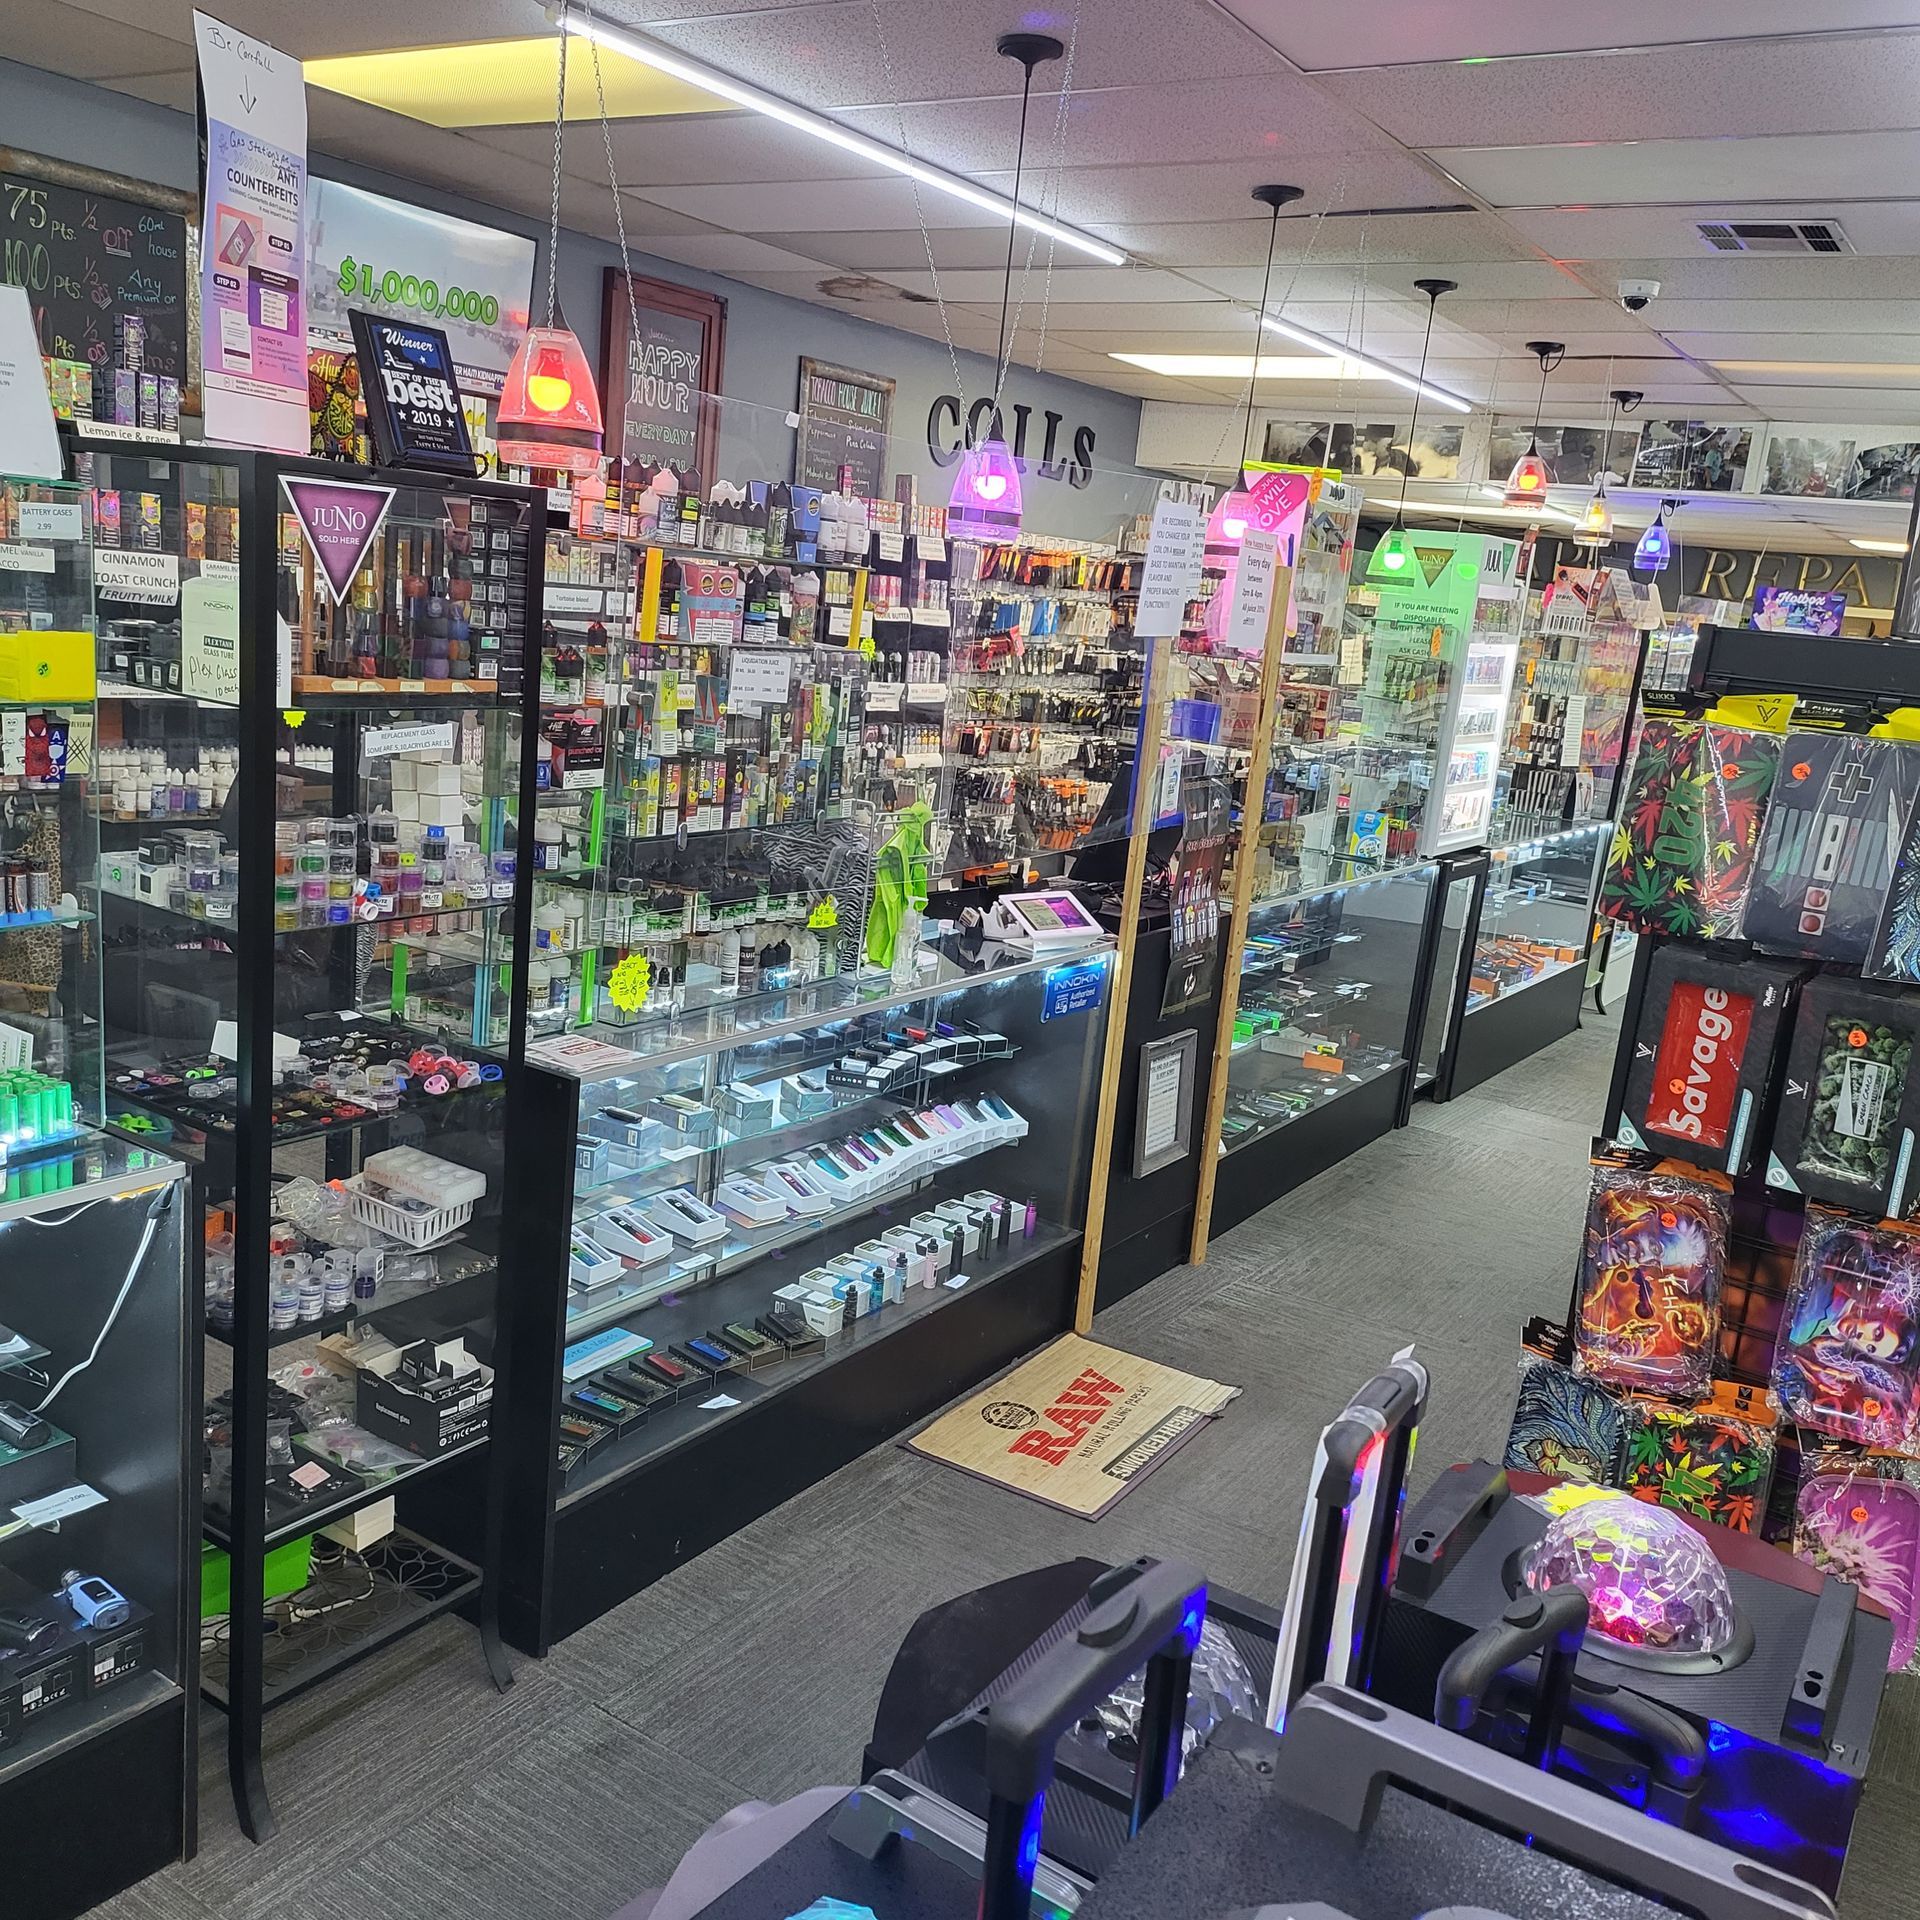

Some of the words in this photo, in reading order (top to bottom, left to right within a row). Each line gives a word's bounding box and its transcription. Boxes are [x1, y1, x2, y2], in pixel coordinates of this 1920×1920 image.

[207, 27, 232, 51] Be
[227, 167, 299, 206] COUNTERFEITS
[277, 169, 299, 189] ANTI
[4, 182, 48, 229] 75
[148, 234, 178, 259] house
[271, 238, 282, 248] STEP
[5, 238, 50, 291] 100
[128, 268, 162, 297] Any
[216, 276, 229, 285] STEP
[117, 286, 160, 304] Premium
[164, 294, 177, 304] or
[336, 255, 499, 326] $1,000,000
[382, 327, 434, 352] Winner
[629, 340, 700, 382] HAPPY
[391, 370, 410, 381] BEST
[411, 373, 423, 383] OF
[423, 375, 441, 387] THE
[381, 368, 458, 413] best
[631, 373, 689, 413] HOUR
[411, 410, 442, 427] 2019
[83, 425, 116, 438] Lemon
[119, 429, 133, 440] ice
[135, 432, 142, 441] &
[927, 395, 1095, 490] COILS
[1260, 478, 1292, 506] WILL
[22, 508, 51, 516] BATTERY
[52, 508, 73, 516] CASES
[318, 534, 338, 544] SOLD
[339, 537, 360, 546] HERE
[102, 553, 165, 568] CINNAMON
[1248, 555, 1260, 571] Every
[1261, 558, 1271, 572] day
[95, 573, 130, 585] TOAST
[133, 575, 176, 589] CRUNCH
[104, 590, 145, 602] FRUITY
[147, 594, 174, 605] MILK
[1776, 591, 1826, 605] Hotbox
[1429, 606, 1459, 615] NEEDING
[203, 648, 219, 657] GLASS
[220, 650, 234, 660] TUBE
[216, 663, 237, 680] Glass
[381, 730, 419, 740] REPLACEMENT
[420, 728, 436, 736] GLASS
[367, 745, 382, 754] SOME
[382, 744, 393, 752] ARE
[665, 763, 673, 807] SUPREME
[1653, 778, 1705, 866] 420
[1054, 973, 1100, 992] INNOKIN
[1070, 987, 1096, 1001] Authorized
[1069, 998, 1087, 1010] Retailer
[1668, 987, 1733, 1139] Savage
[1858, 1102, 1868, 1126] GREEN
[1007, 1366, 1126, 1467] RAW
[1077, 1430, 1112, 1460] NATURAL
[1108, 1406, 1131, 1433] ROLLING
